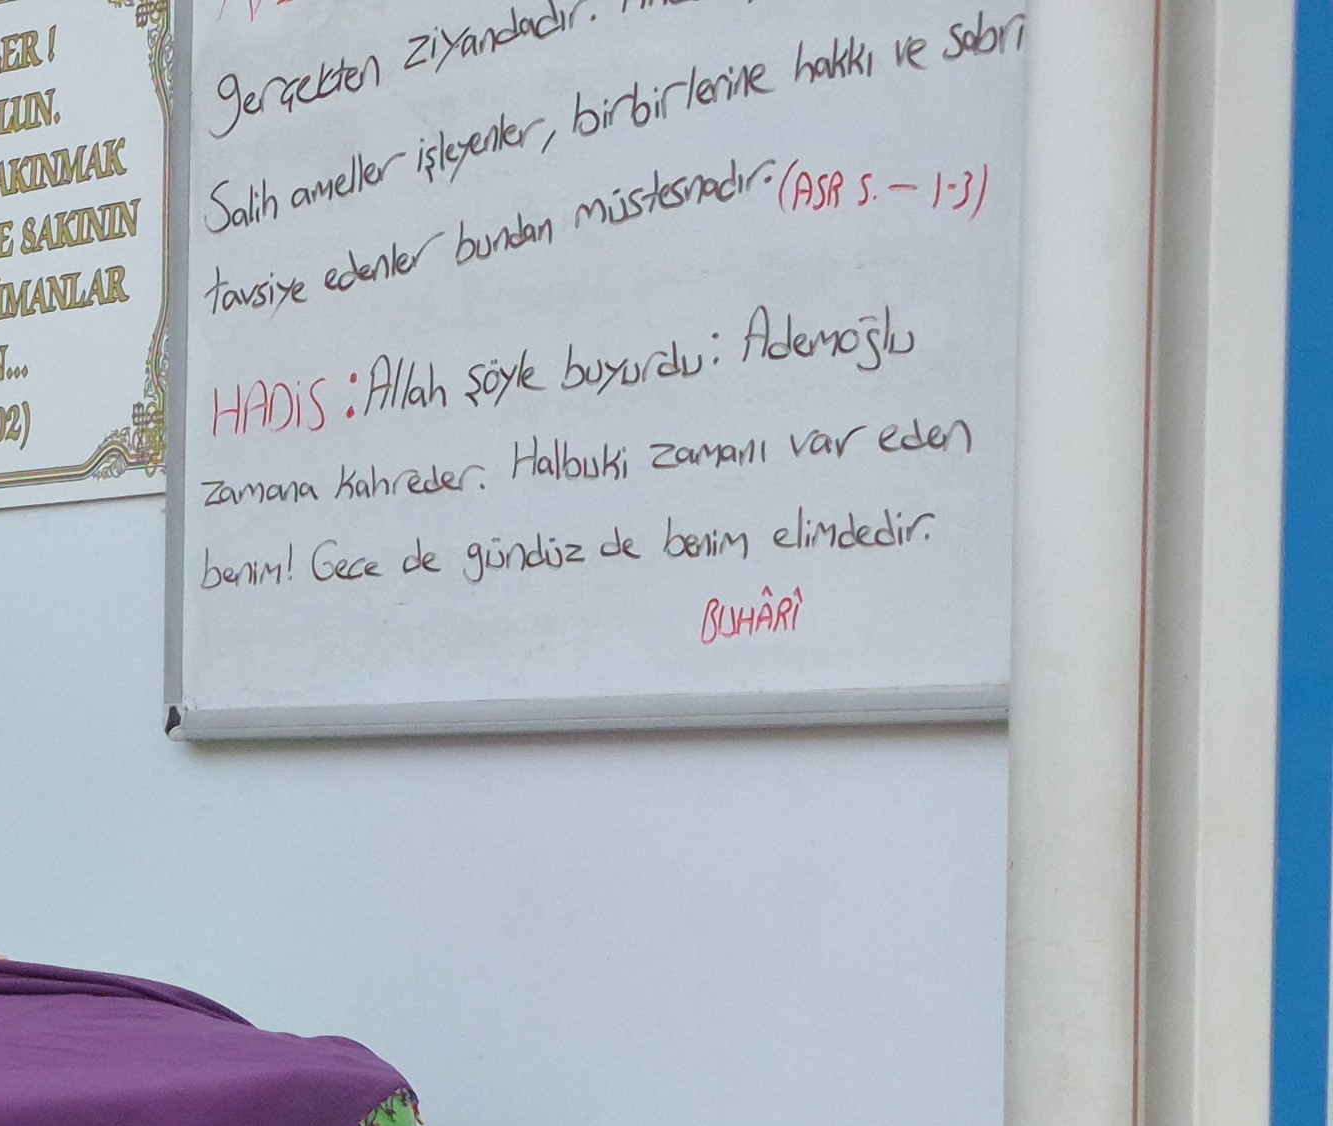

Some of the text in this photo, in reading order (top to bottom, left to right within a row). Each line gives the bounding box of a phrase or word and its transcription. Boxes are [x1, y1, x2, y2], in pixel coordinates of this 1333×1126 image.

[204, 179, 278, 235] Salih
[290, 151, 407, 209] ameller
[417, 112, 557, 184] işleyenler,
[572, 62, 777, 137] birbirlerine
[793, 35, 874, 84] hakkı
[895, 34, 929, 70] ve
[208, 55, 380, 139] gerçekten
[19, 197, 142, 255] SAKININ
[204, 265, 309, 319] tavsiye
[323, 232, 446, 292] edenler
[455, 212, 554, 267] bundan
[574, 158, 777, 229] müstesnadır.
[778, 159, 844, 215] (ASR
[933, 163, 989, 221] 1-3)
[363, 352, 448, 417] Allah
[464, 348, 547, 409] şöyle
[741, 303, 917, 372] Ademoğlu
[201, 479, 320, 508] zamana
[649, 438, 767, 471] zamanı
[790, 425, 868, 459] var
[878, 417, 973, 454] eden
[200, 505, 936, 590] benim! Gece de gündüz de benim elimdedir.
